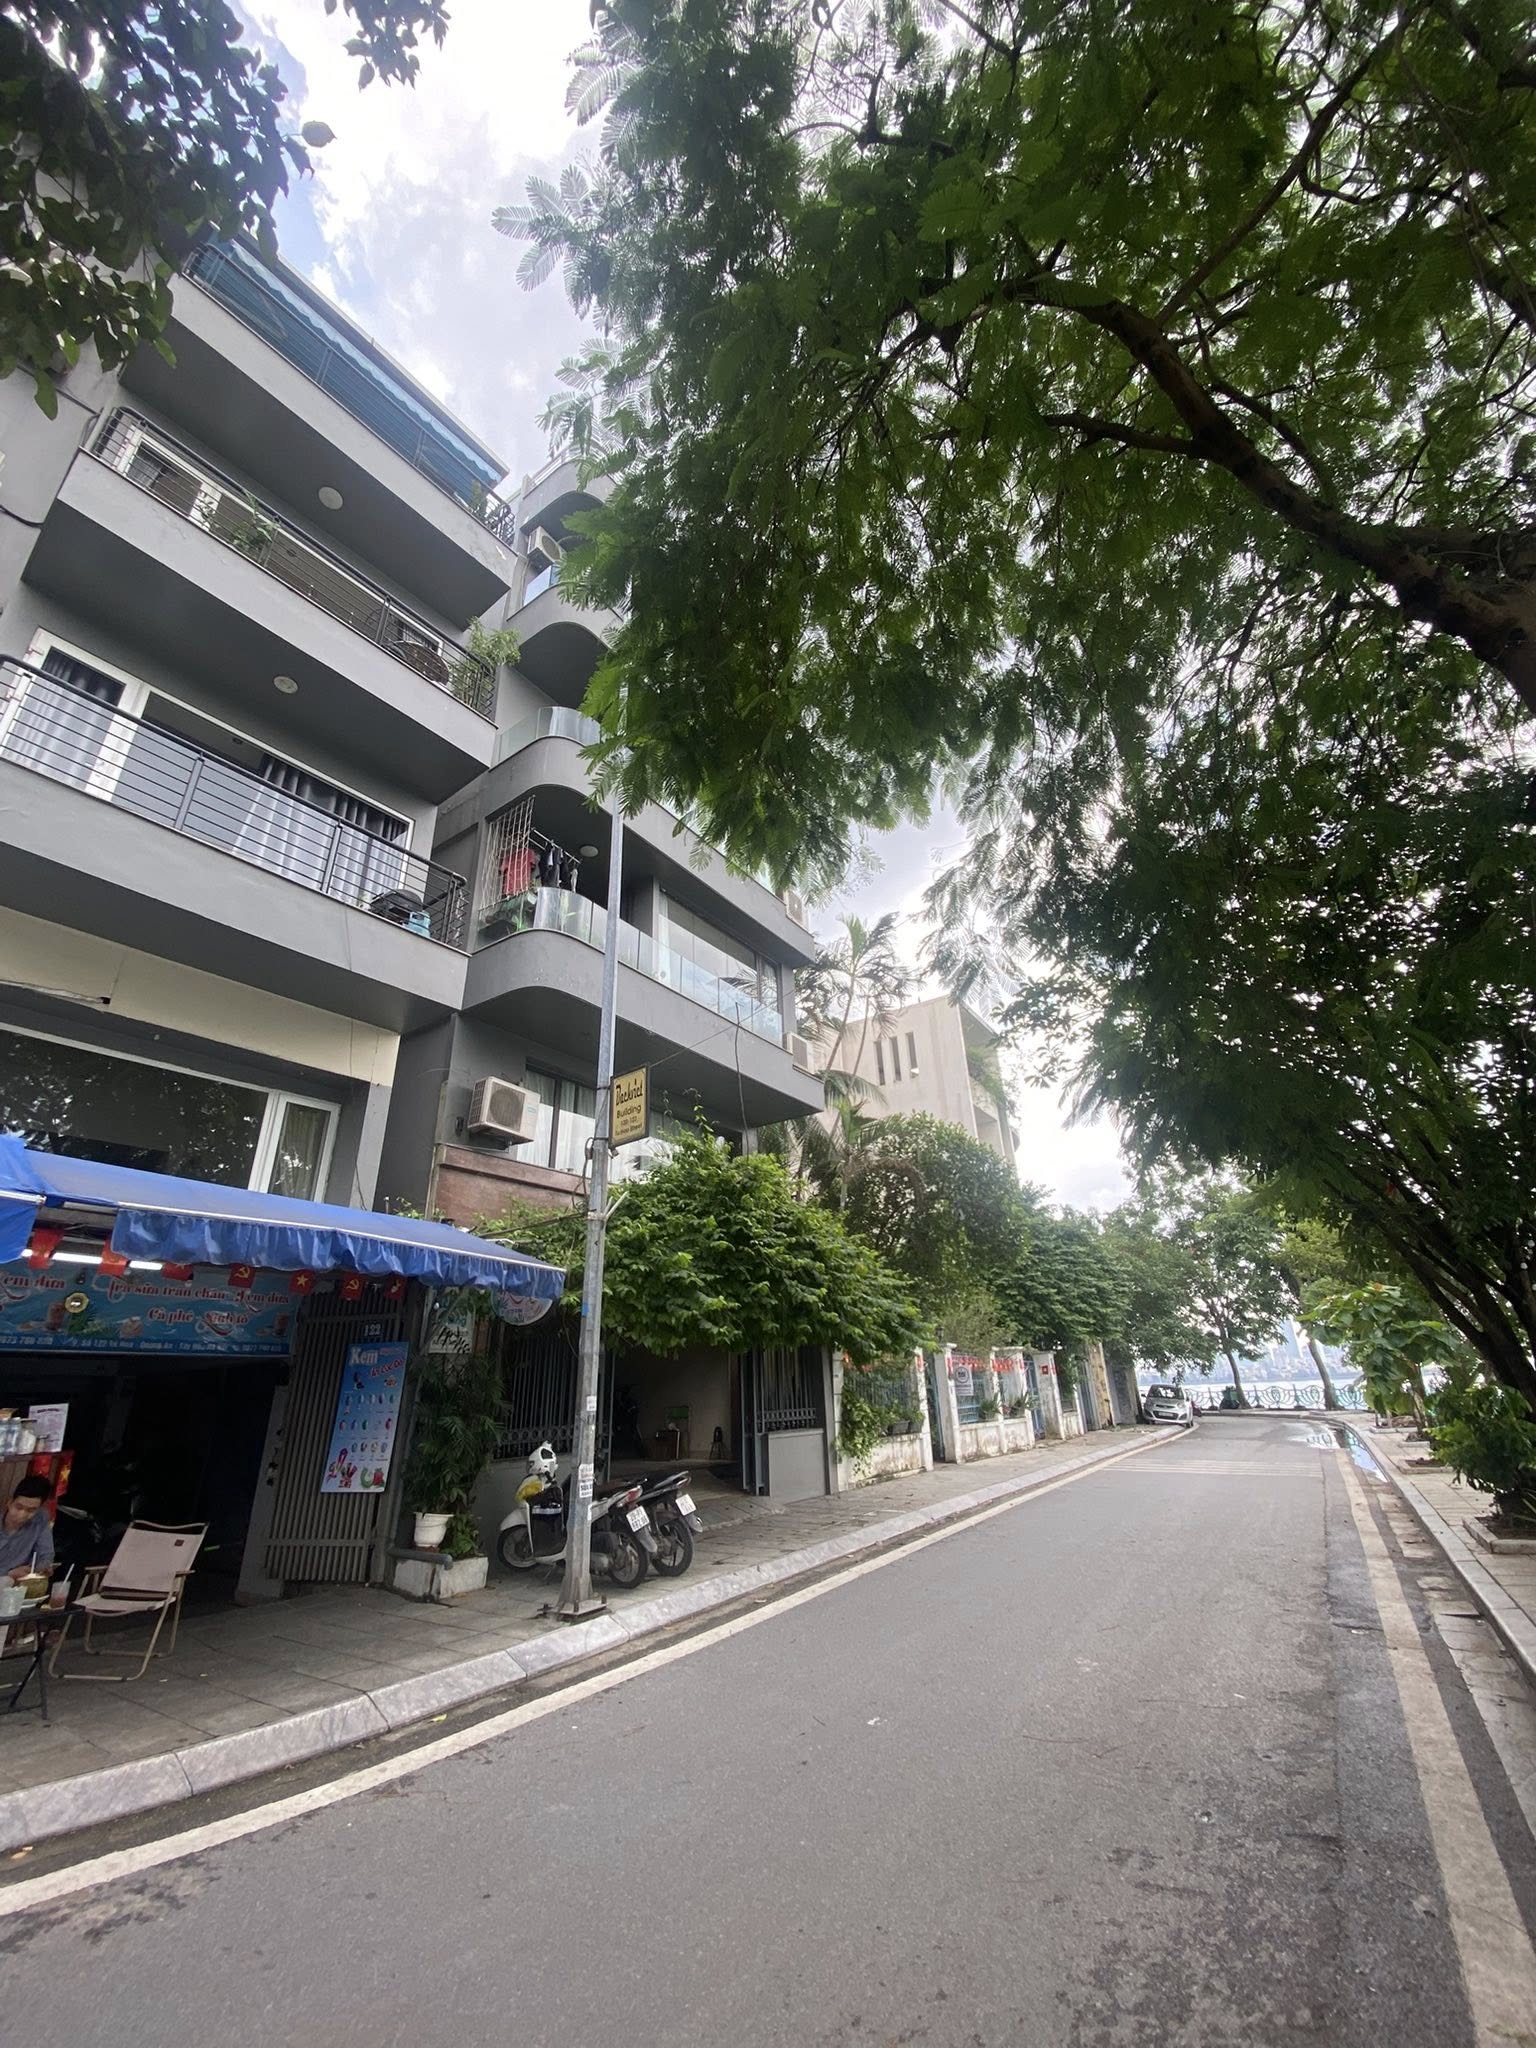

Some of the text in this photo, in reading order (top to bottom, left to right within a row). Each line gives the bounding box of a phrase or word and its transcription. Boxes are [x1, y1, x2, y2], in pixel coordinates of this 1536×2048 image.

[617, 1105, 642, 1119] Building
[364, 1322, 382, 1336] 122
[350, 1345, 379, 1365] Kem
